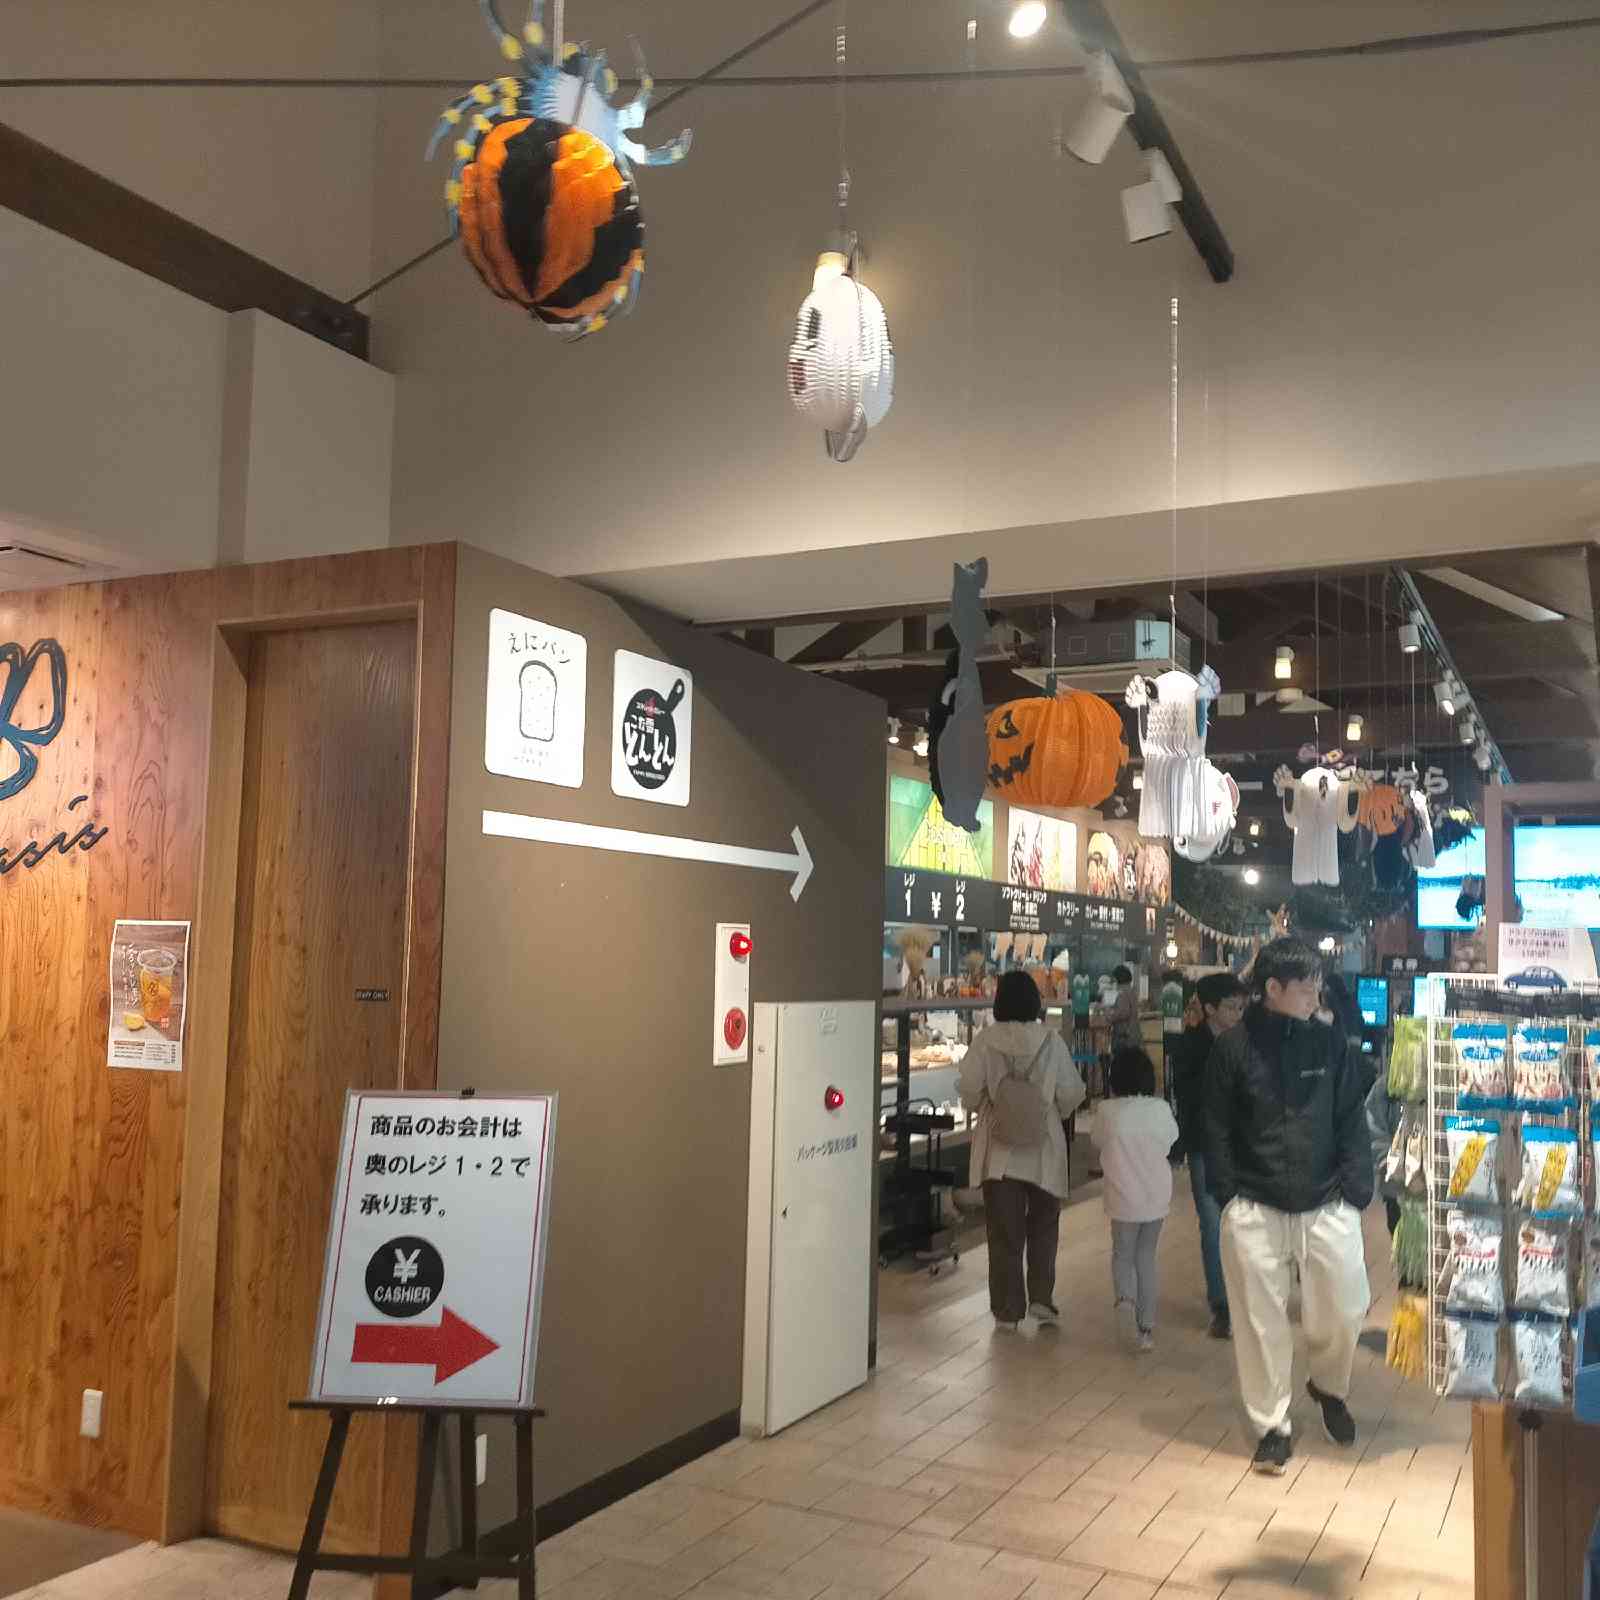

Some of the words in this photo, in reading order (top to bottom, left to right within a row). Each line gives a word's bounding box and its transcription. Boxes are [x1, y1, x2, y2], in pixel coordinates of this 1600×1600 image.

[508, 632, 571, 664] えにパン
[905, 888, 912, 917] 1
[955, 893, 965, 921] 2
[371, 1114, 523, 1139] 商品のお会計は
[360, 1193, 447, 1218] 承ります。
[374, 1285, 431, 1305] CASHIER
